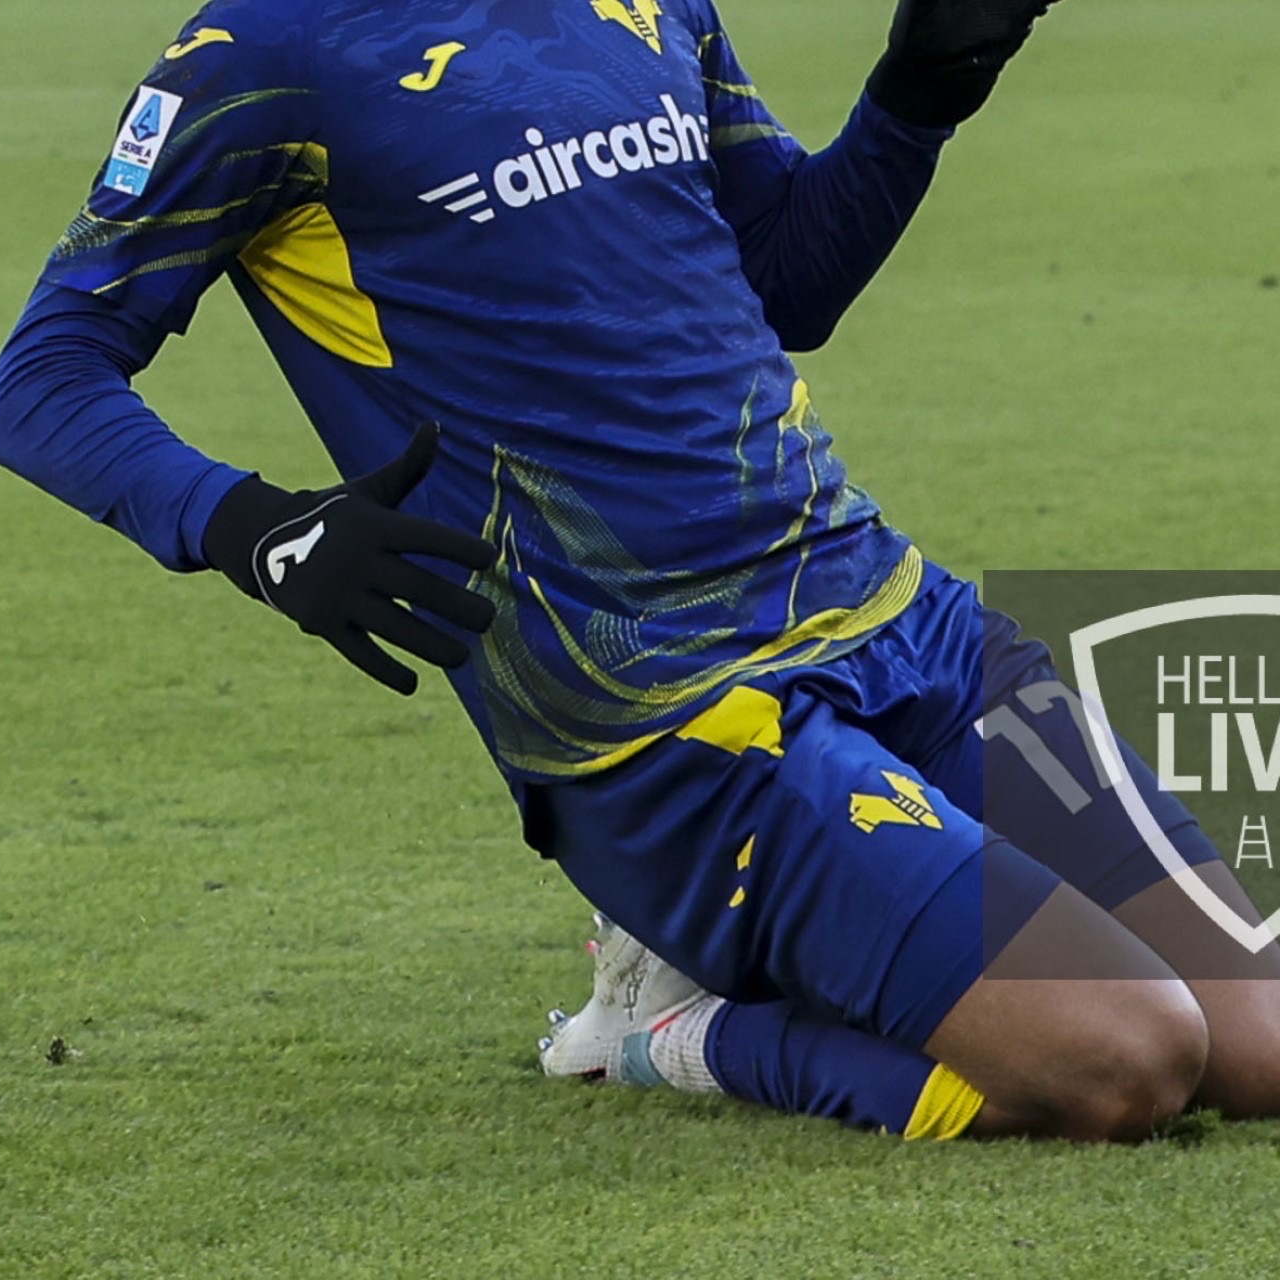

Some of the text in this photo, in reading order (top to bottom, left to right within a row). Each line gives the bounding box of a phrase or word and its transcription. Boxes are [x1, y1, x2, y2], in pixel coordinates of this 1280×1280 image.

[120, 140, 151, 158] SERIE A
[493, 93, 709, 208] aircash
